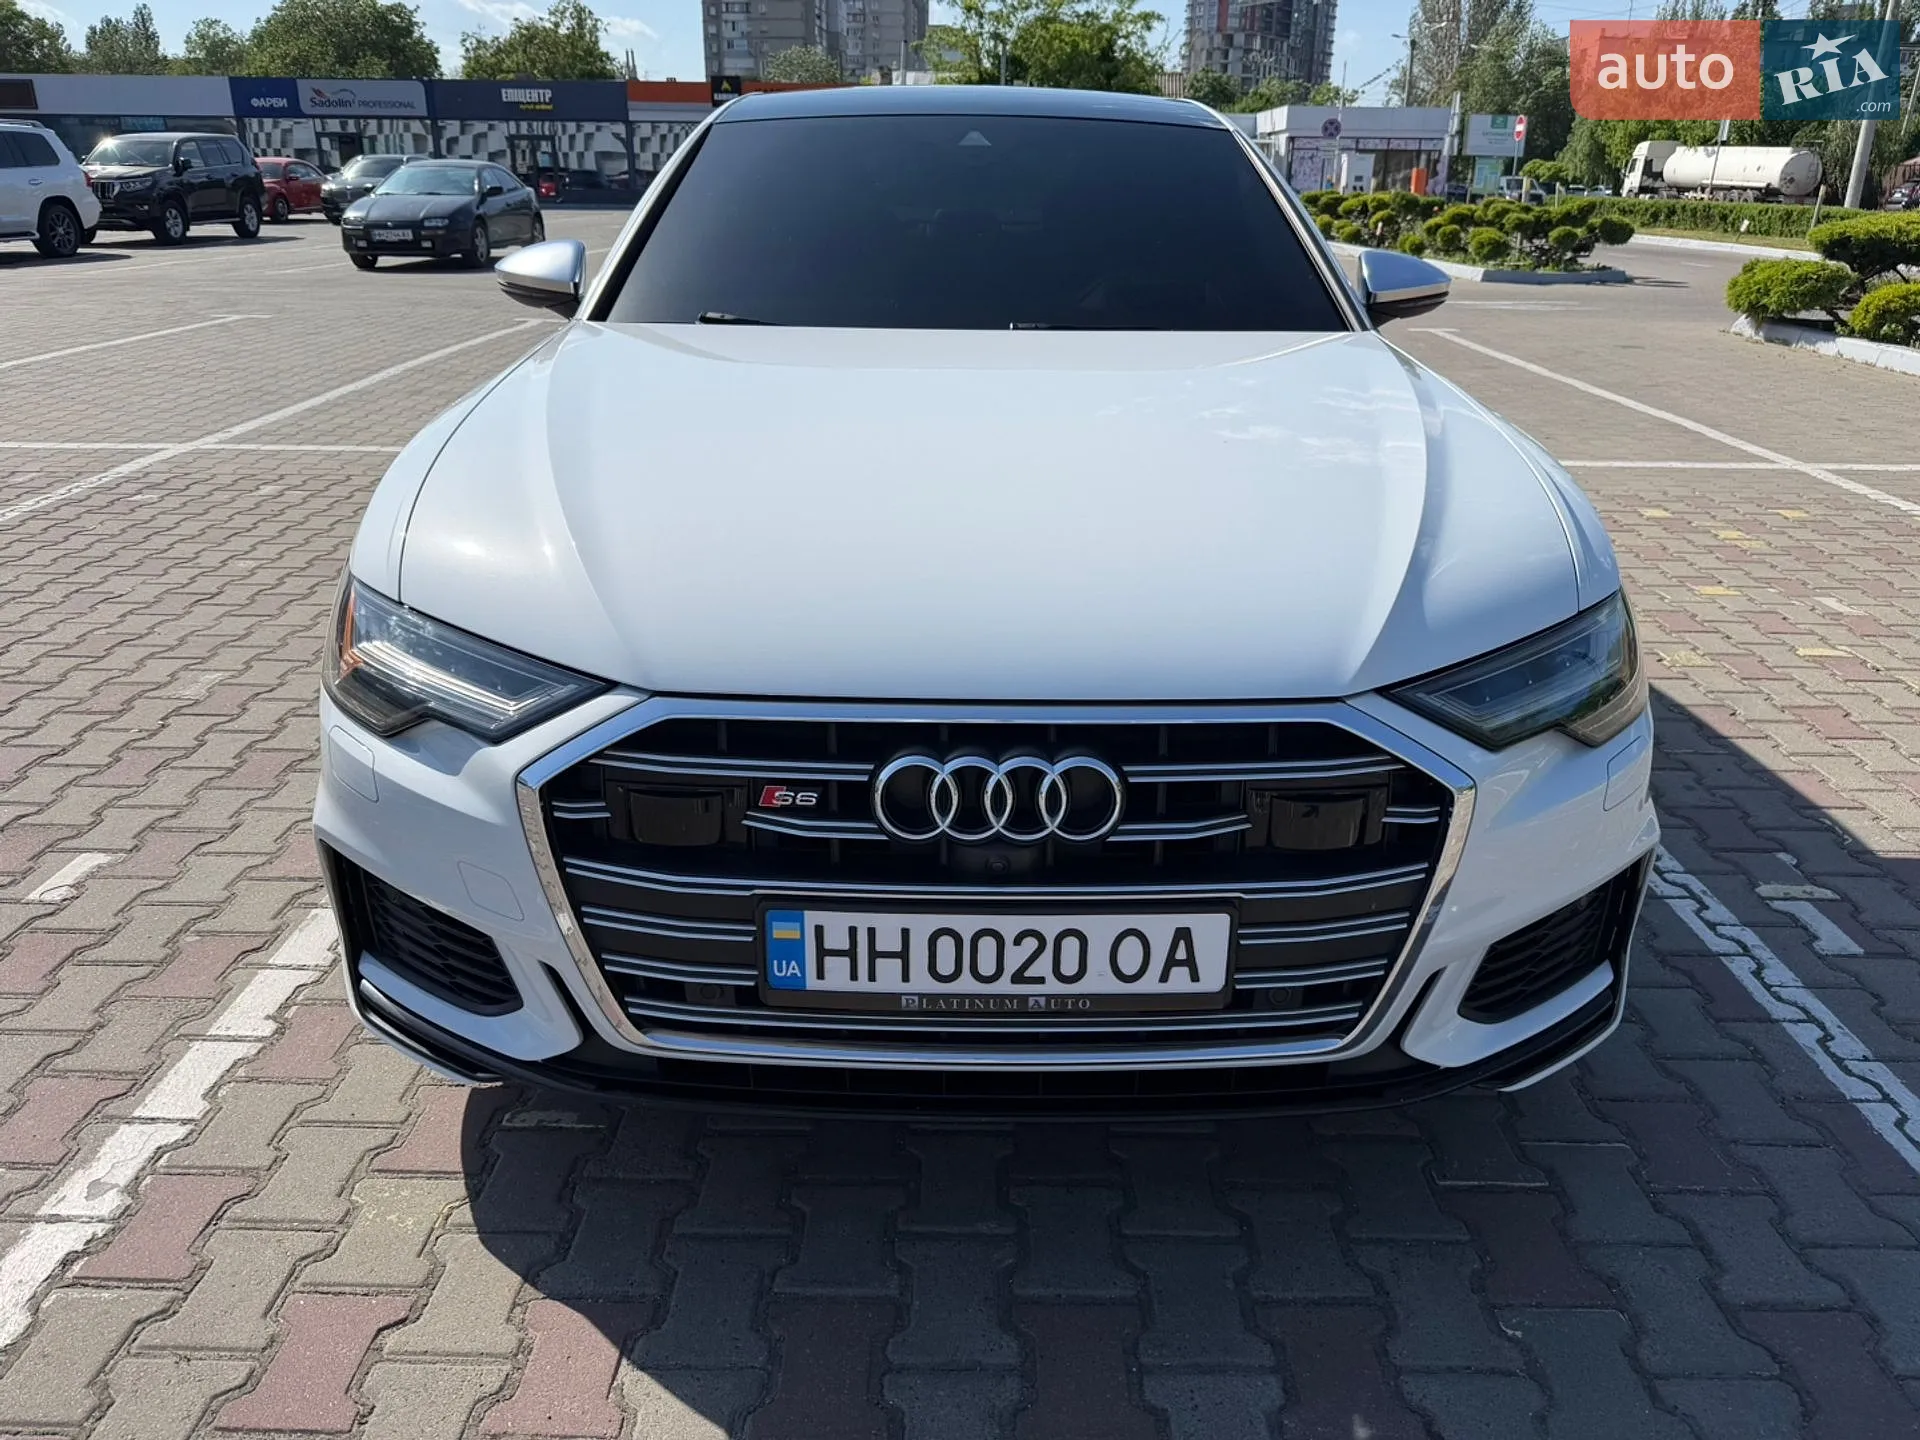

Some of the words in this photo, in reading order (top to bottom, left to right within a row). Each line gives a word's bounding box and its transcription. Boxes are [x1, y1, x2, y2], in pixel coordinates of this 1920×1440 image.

[250, 97, 288, 108] ФАРБИ
[501, 88, 552, 103] ЕПІЦЕНТР
[357, 100, 416, 110] PROFESSIONAL
[772, 791, 818, 805] S6
[814, 924, 911, 983] HH
[927, 927, 1089, 986] 0020
[1109, 926, 1200, 984] OA
[773, 959, 801, 977] UA
[901, 996, 1018, 1009] PLATINUM
[1029, 997, 1091, 1011] AUTO
